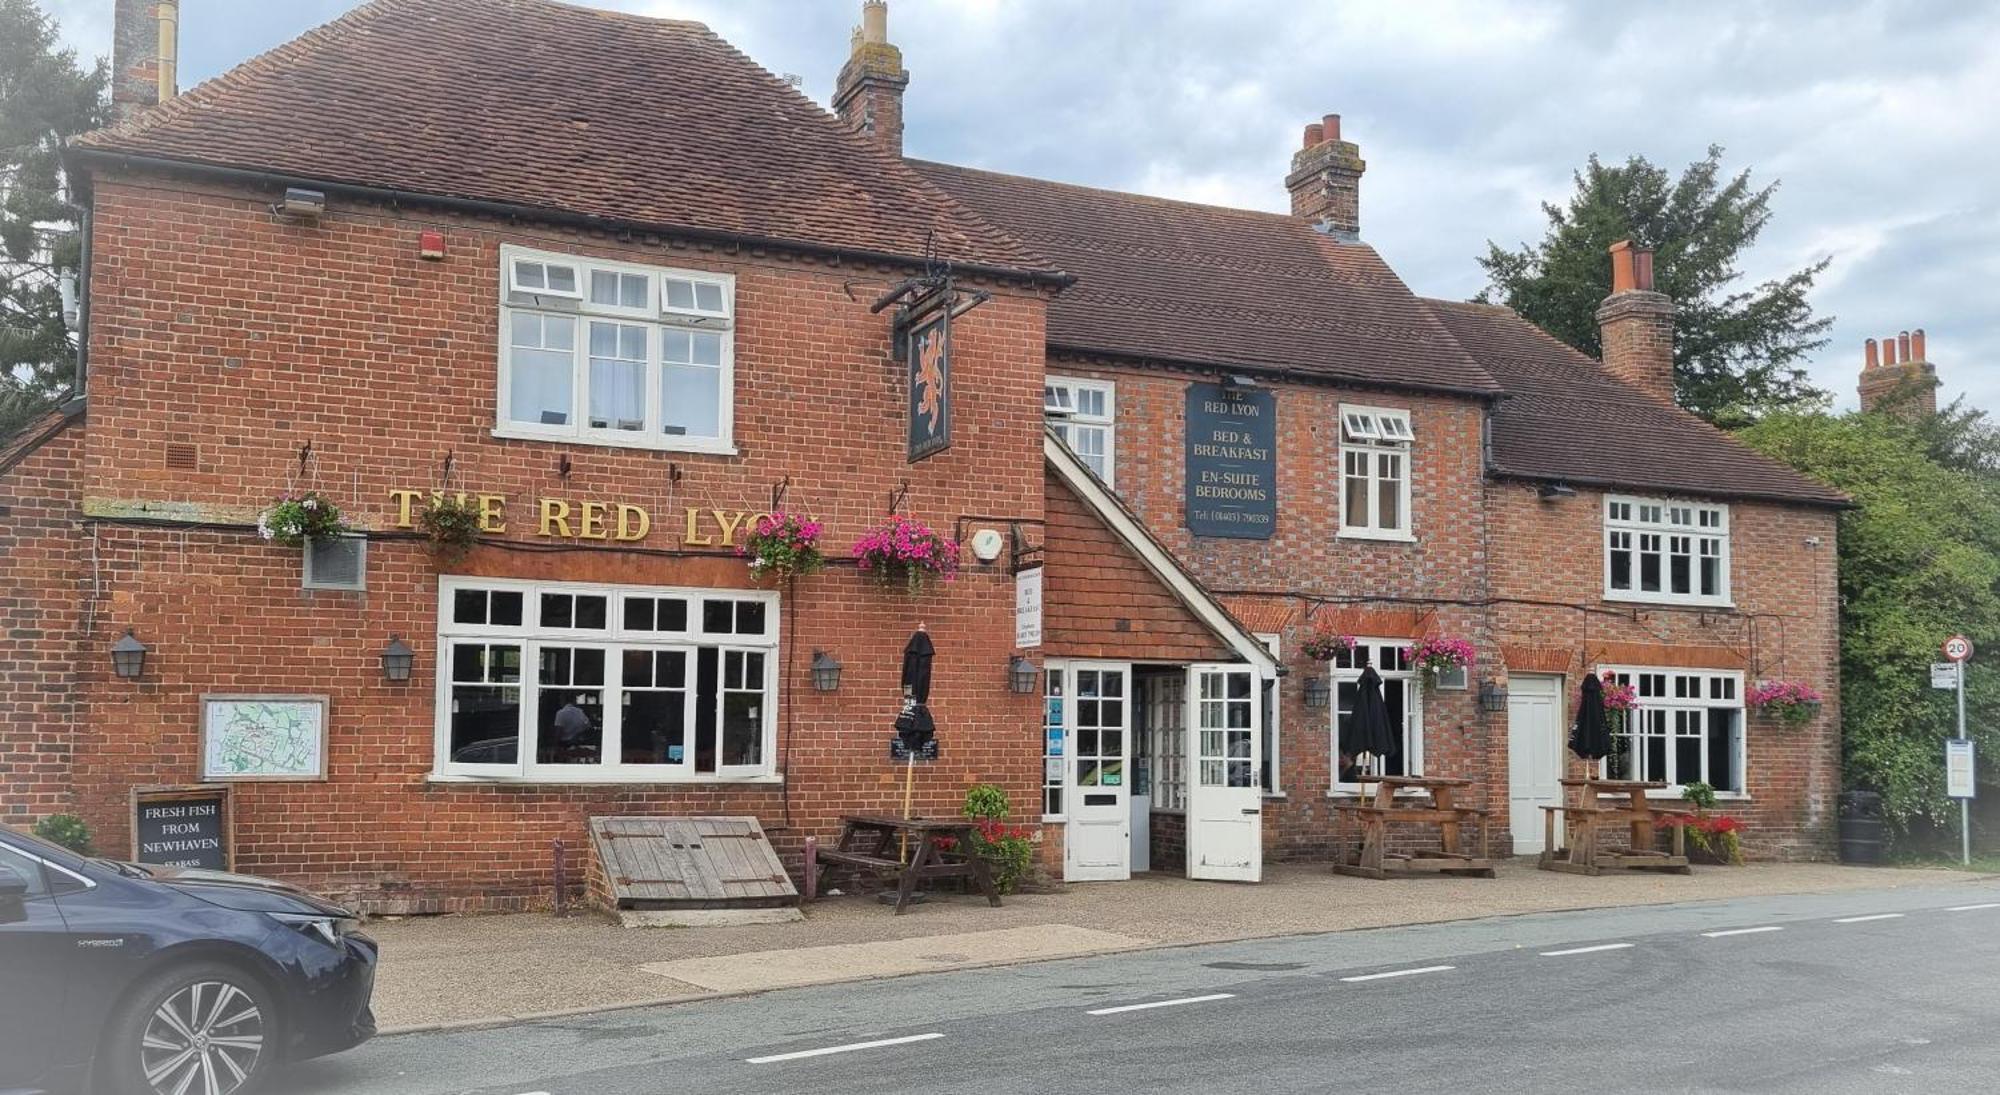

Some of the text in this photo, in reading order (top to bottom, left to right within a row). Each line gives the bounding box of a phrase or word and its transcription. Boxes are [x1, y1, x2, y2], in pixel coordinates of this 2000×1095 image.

[1204, 400, 1260, 417] RED LYON
[1213, 430, 1253, 445] BED &
[1194, 443, 1269, 461] BREAKFAST
[1201, 470, 1260, 487] EN-SUITE
[1195, 485, 1267, 501] BEDROOMS
[536, 498, 651, 542] RED
[1949, 643, 1966, 653] 20
[145, 805, 216, 820] FRESH FISH
[162, 822, 201, 835] FROM
[143, 838, 219, 854] NEWHAVEN
